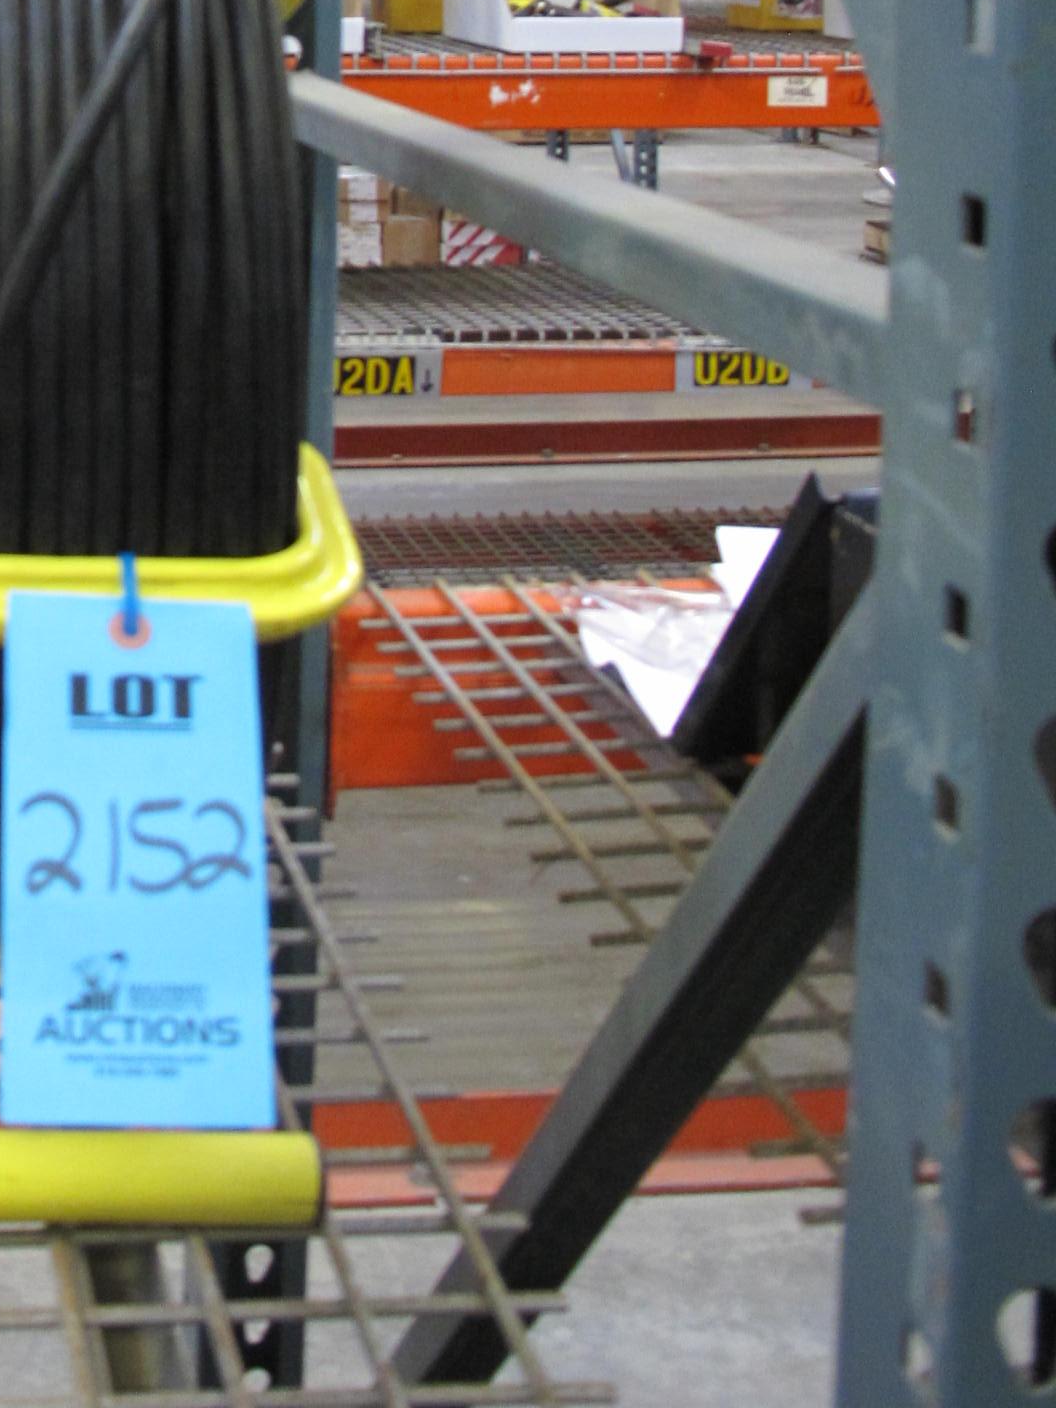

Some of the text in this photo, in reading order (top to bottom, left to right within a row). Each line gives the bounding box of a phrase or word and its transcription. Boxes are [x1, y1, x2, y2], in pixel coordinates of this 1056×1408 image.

[70, 673, 203, 719] LOT
[19, 791, 253, 895] 2152
[34, 1014, 242, 1047] AUCTIONS
